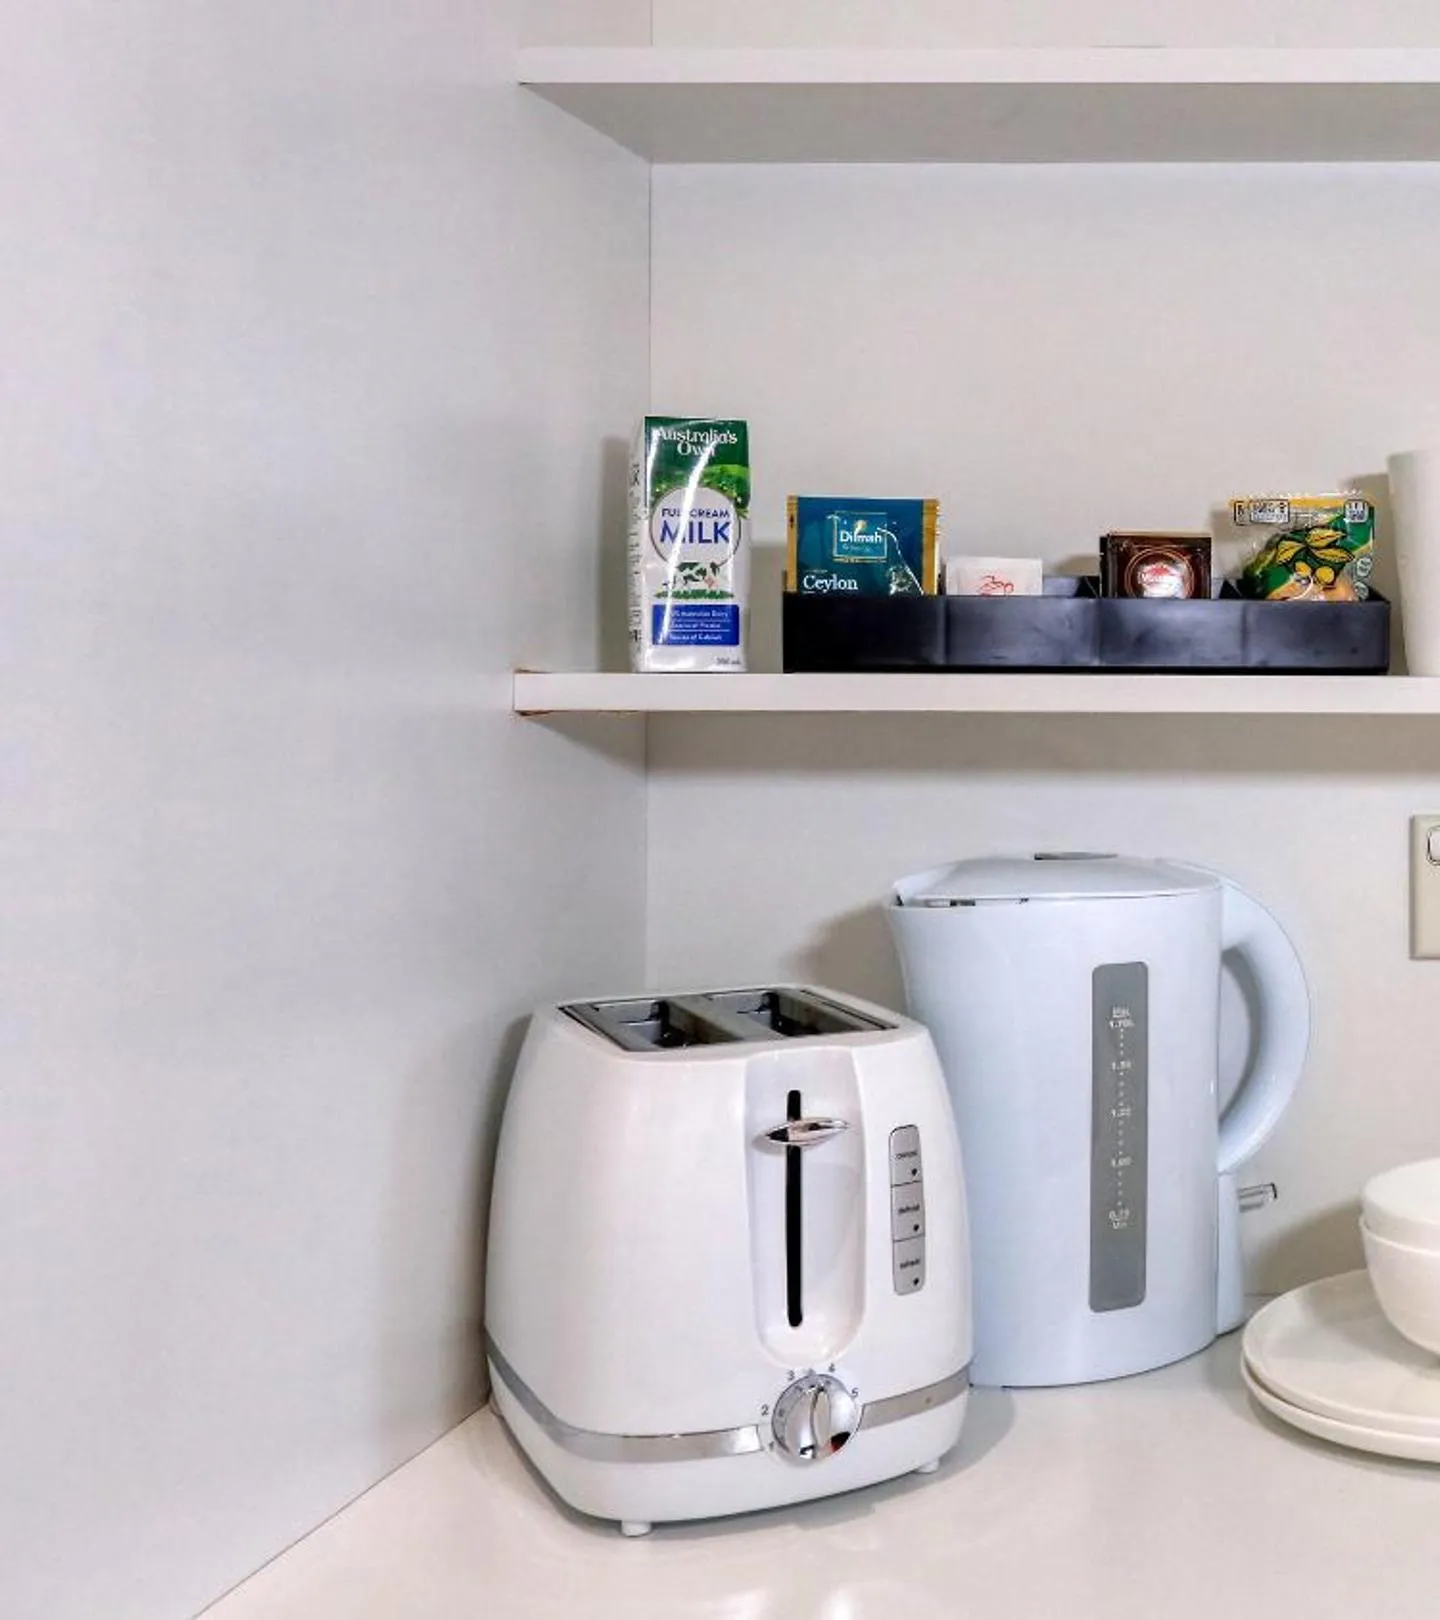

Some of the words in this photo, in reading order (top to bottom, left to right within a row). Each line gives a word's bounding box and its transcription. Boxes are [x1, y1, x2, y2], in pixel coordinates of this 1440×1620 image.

[689, 508, 730, 518] CREAM
[660, 520, 731, 544] MILK
[840, 528, 882, 543] Dilmah
[803, 573, 859, 594] Ceylon
[786, 1370, 795, 1381] 3
[761, 1404, 769, 1416] 2
